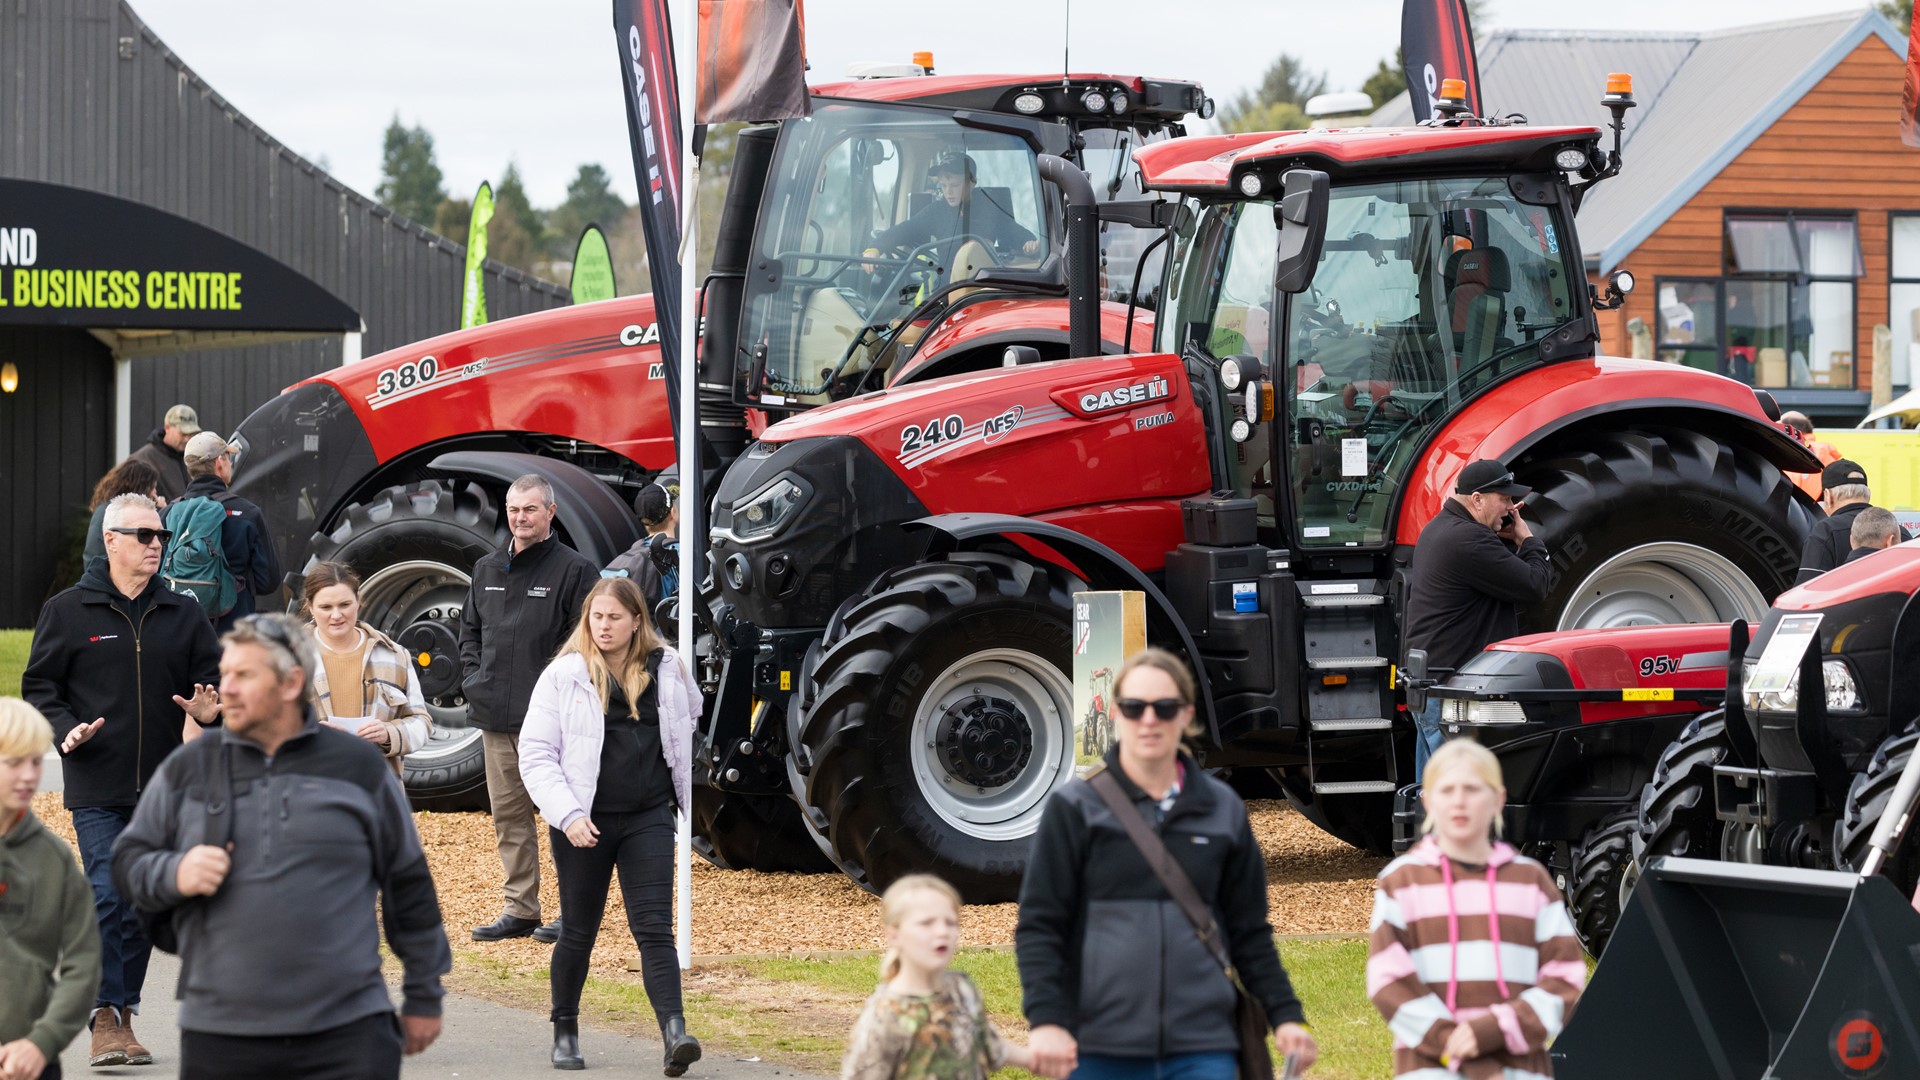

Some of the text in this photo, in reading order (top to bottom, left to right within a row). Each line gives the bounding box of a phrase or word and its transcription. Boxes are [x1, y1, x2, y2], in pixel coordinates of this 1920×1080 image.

[629, 24, 656, 158] CASE
[14, 269, 140, 309] BUSINESS
[146, 271, 242, 310] CENTRE
[377, 356, 482, 397] 380 AFS
[1080, 384, 1146, 413] CASE
[901, 409, 1016, 453] 240 AFS
[1135, 411, 1176, 430] PUMA
[1326, 481, 1381, 491] CVXDrive
[1077, 603, 1090, 620] GEAR
[1077, 621, 1090, 654] UP
